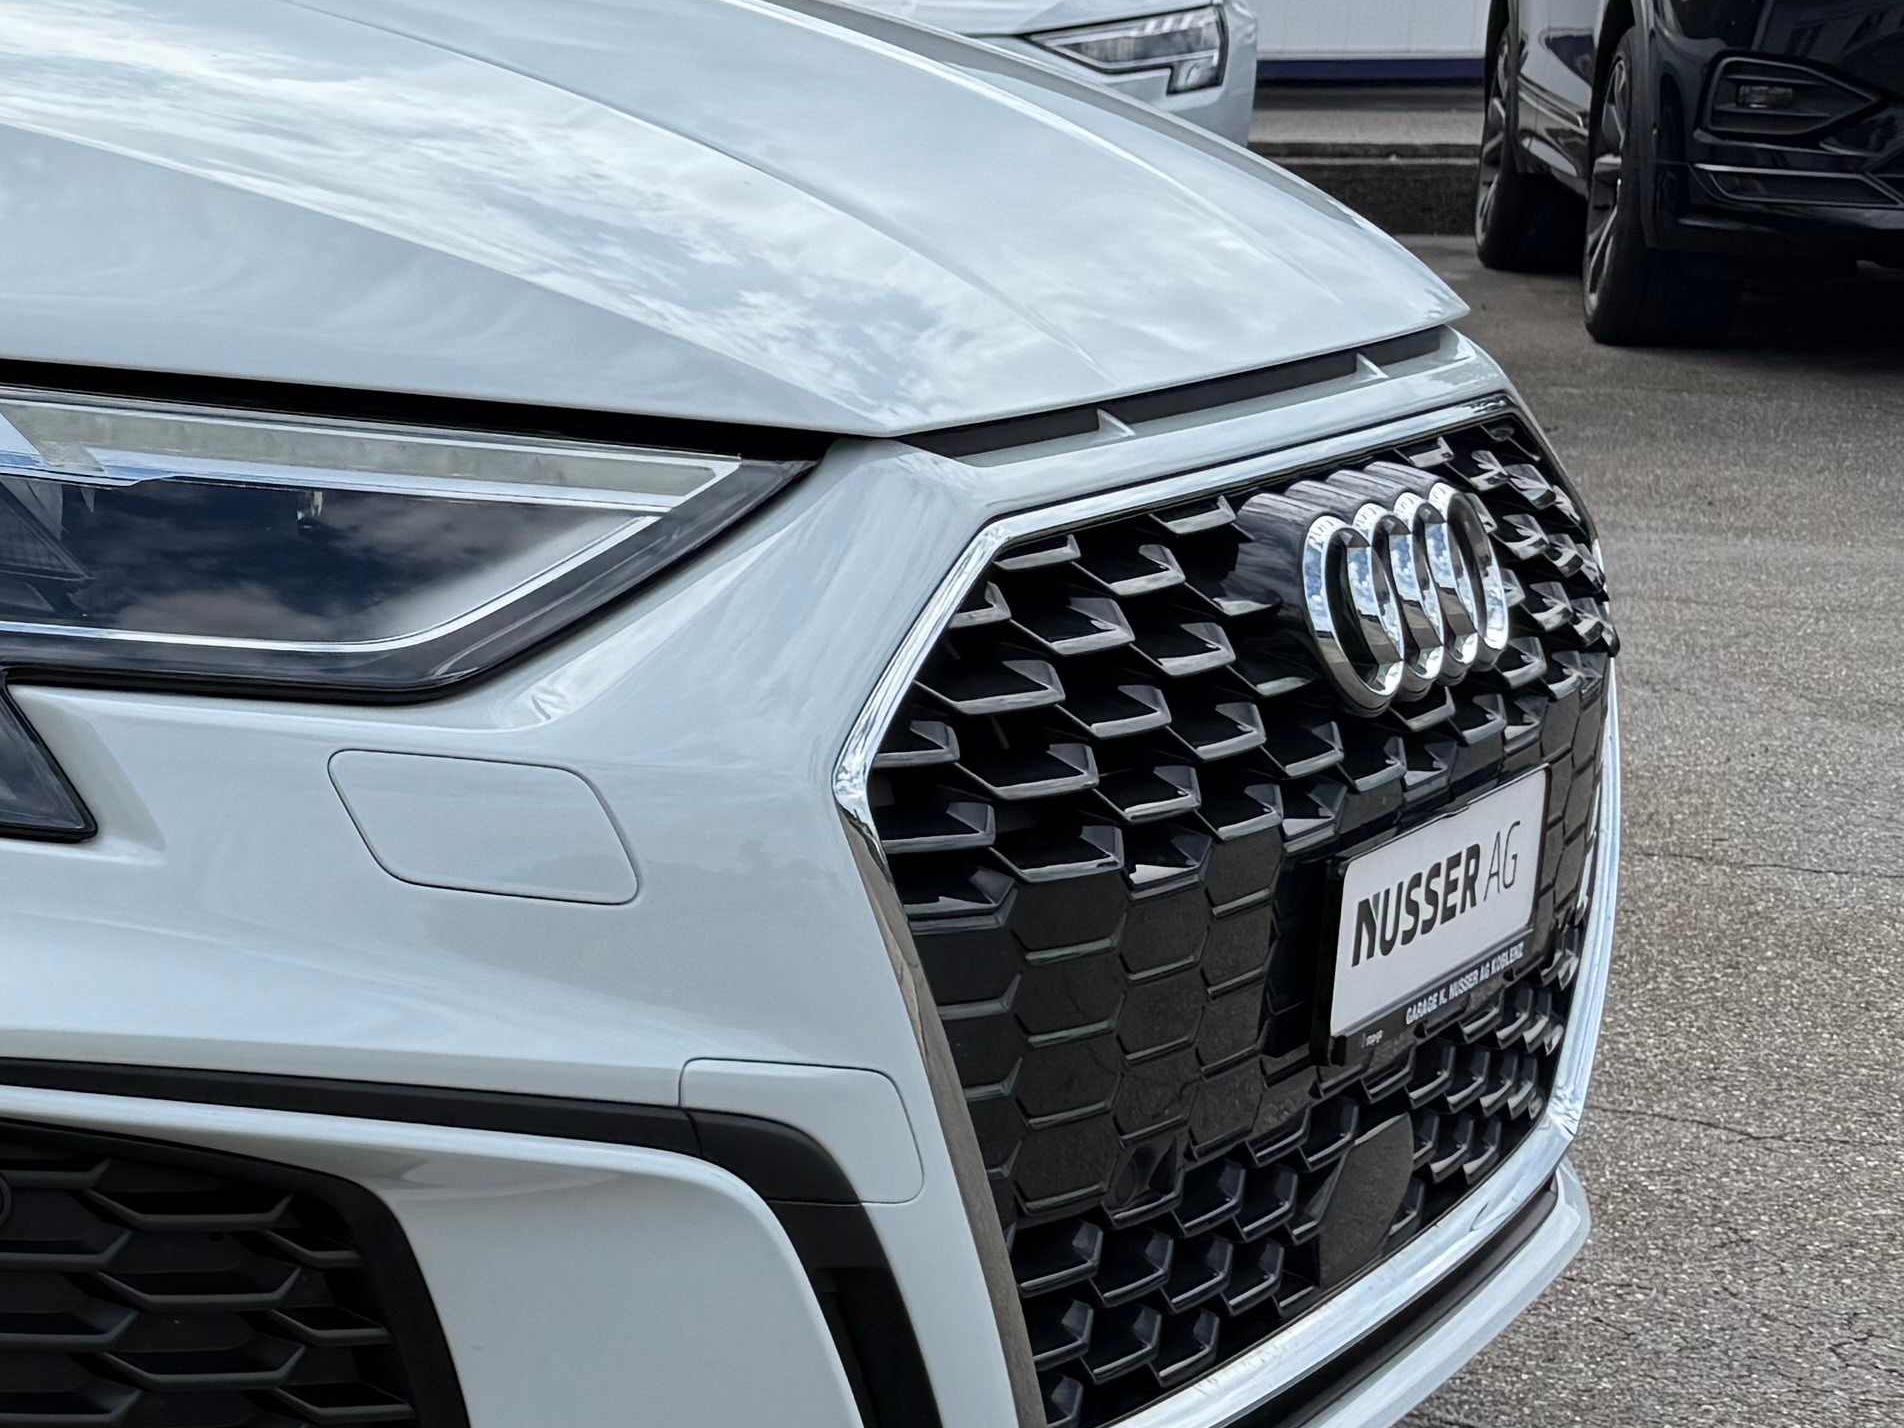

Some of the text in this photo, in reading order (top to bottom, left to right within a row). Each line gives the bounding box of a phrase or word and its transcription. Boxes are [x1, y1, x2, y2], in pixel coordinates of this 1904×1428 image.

[1352, 821, 1521, 967] NUSSER AG
[1405, 992, 1438, 1025] GARAGE
[1449, 969, 1479, 1000] NUSSER
[1479, 962, 1490, 982] AG
[1491, 941, 1525, 974] KOBLENZ
